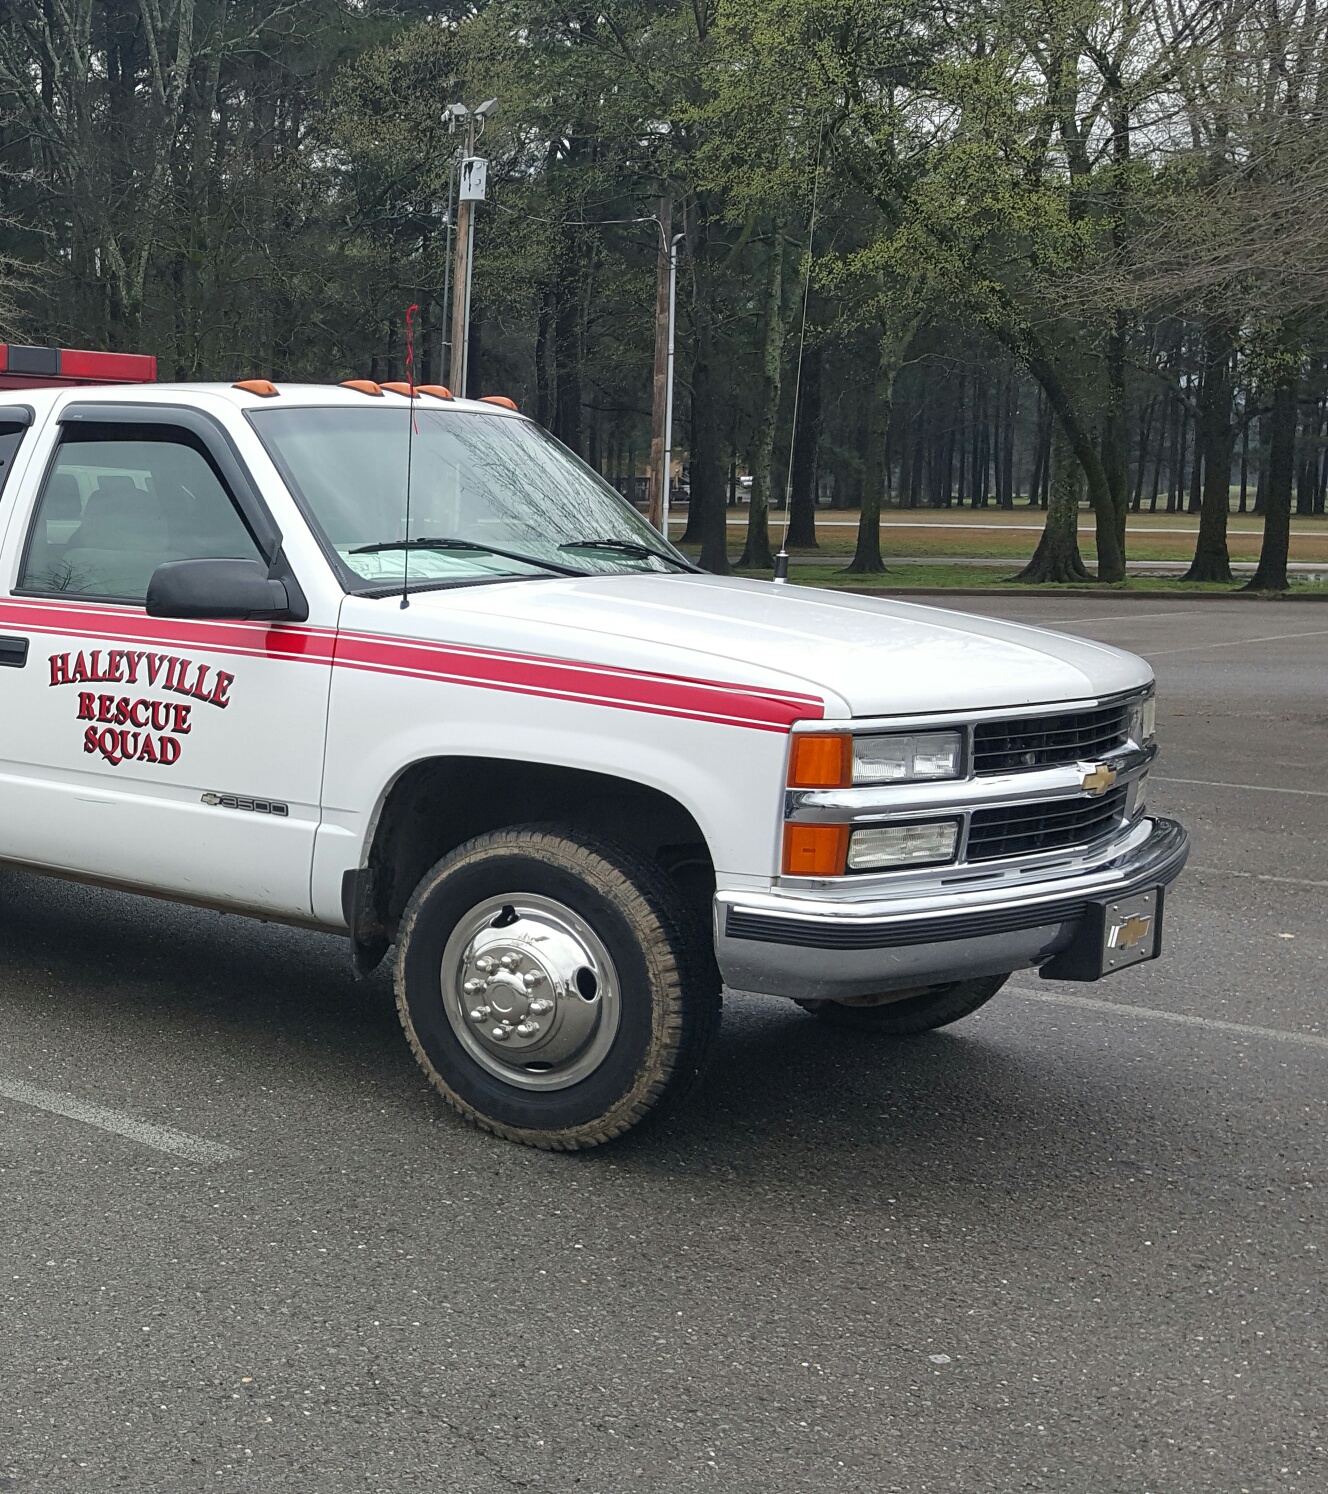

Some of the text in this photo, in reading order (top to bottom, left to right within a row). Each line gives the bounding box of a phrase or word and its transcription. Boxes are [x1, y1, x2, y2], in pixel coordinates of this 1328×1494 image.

[48, 650, 235, 708] HALEYVILLE
[76, 692, 191, 734] RESCUE
[84, 726, 181, 766] SQUAD
[221, 794, 288, 817] 3500
